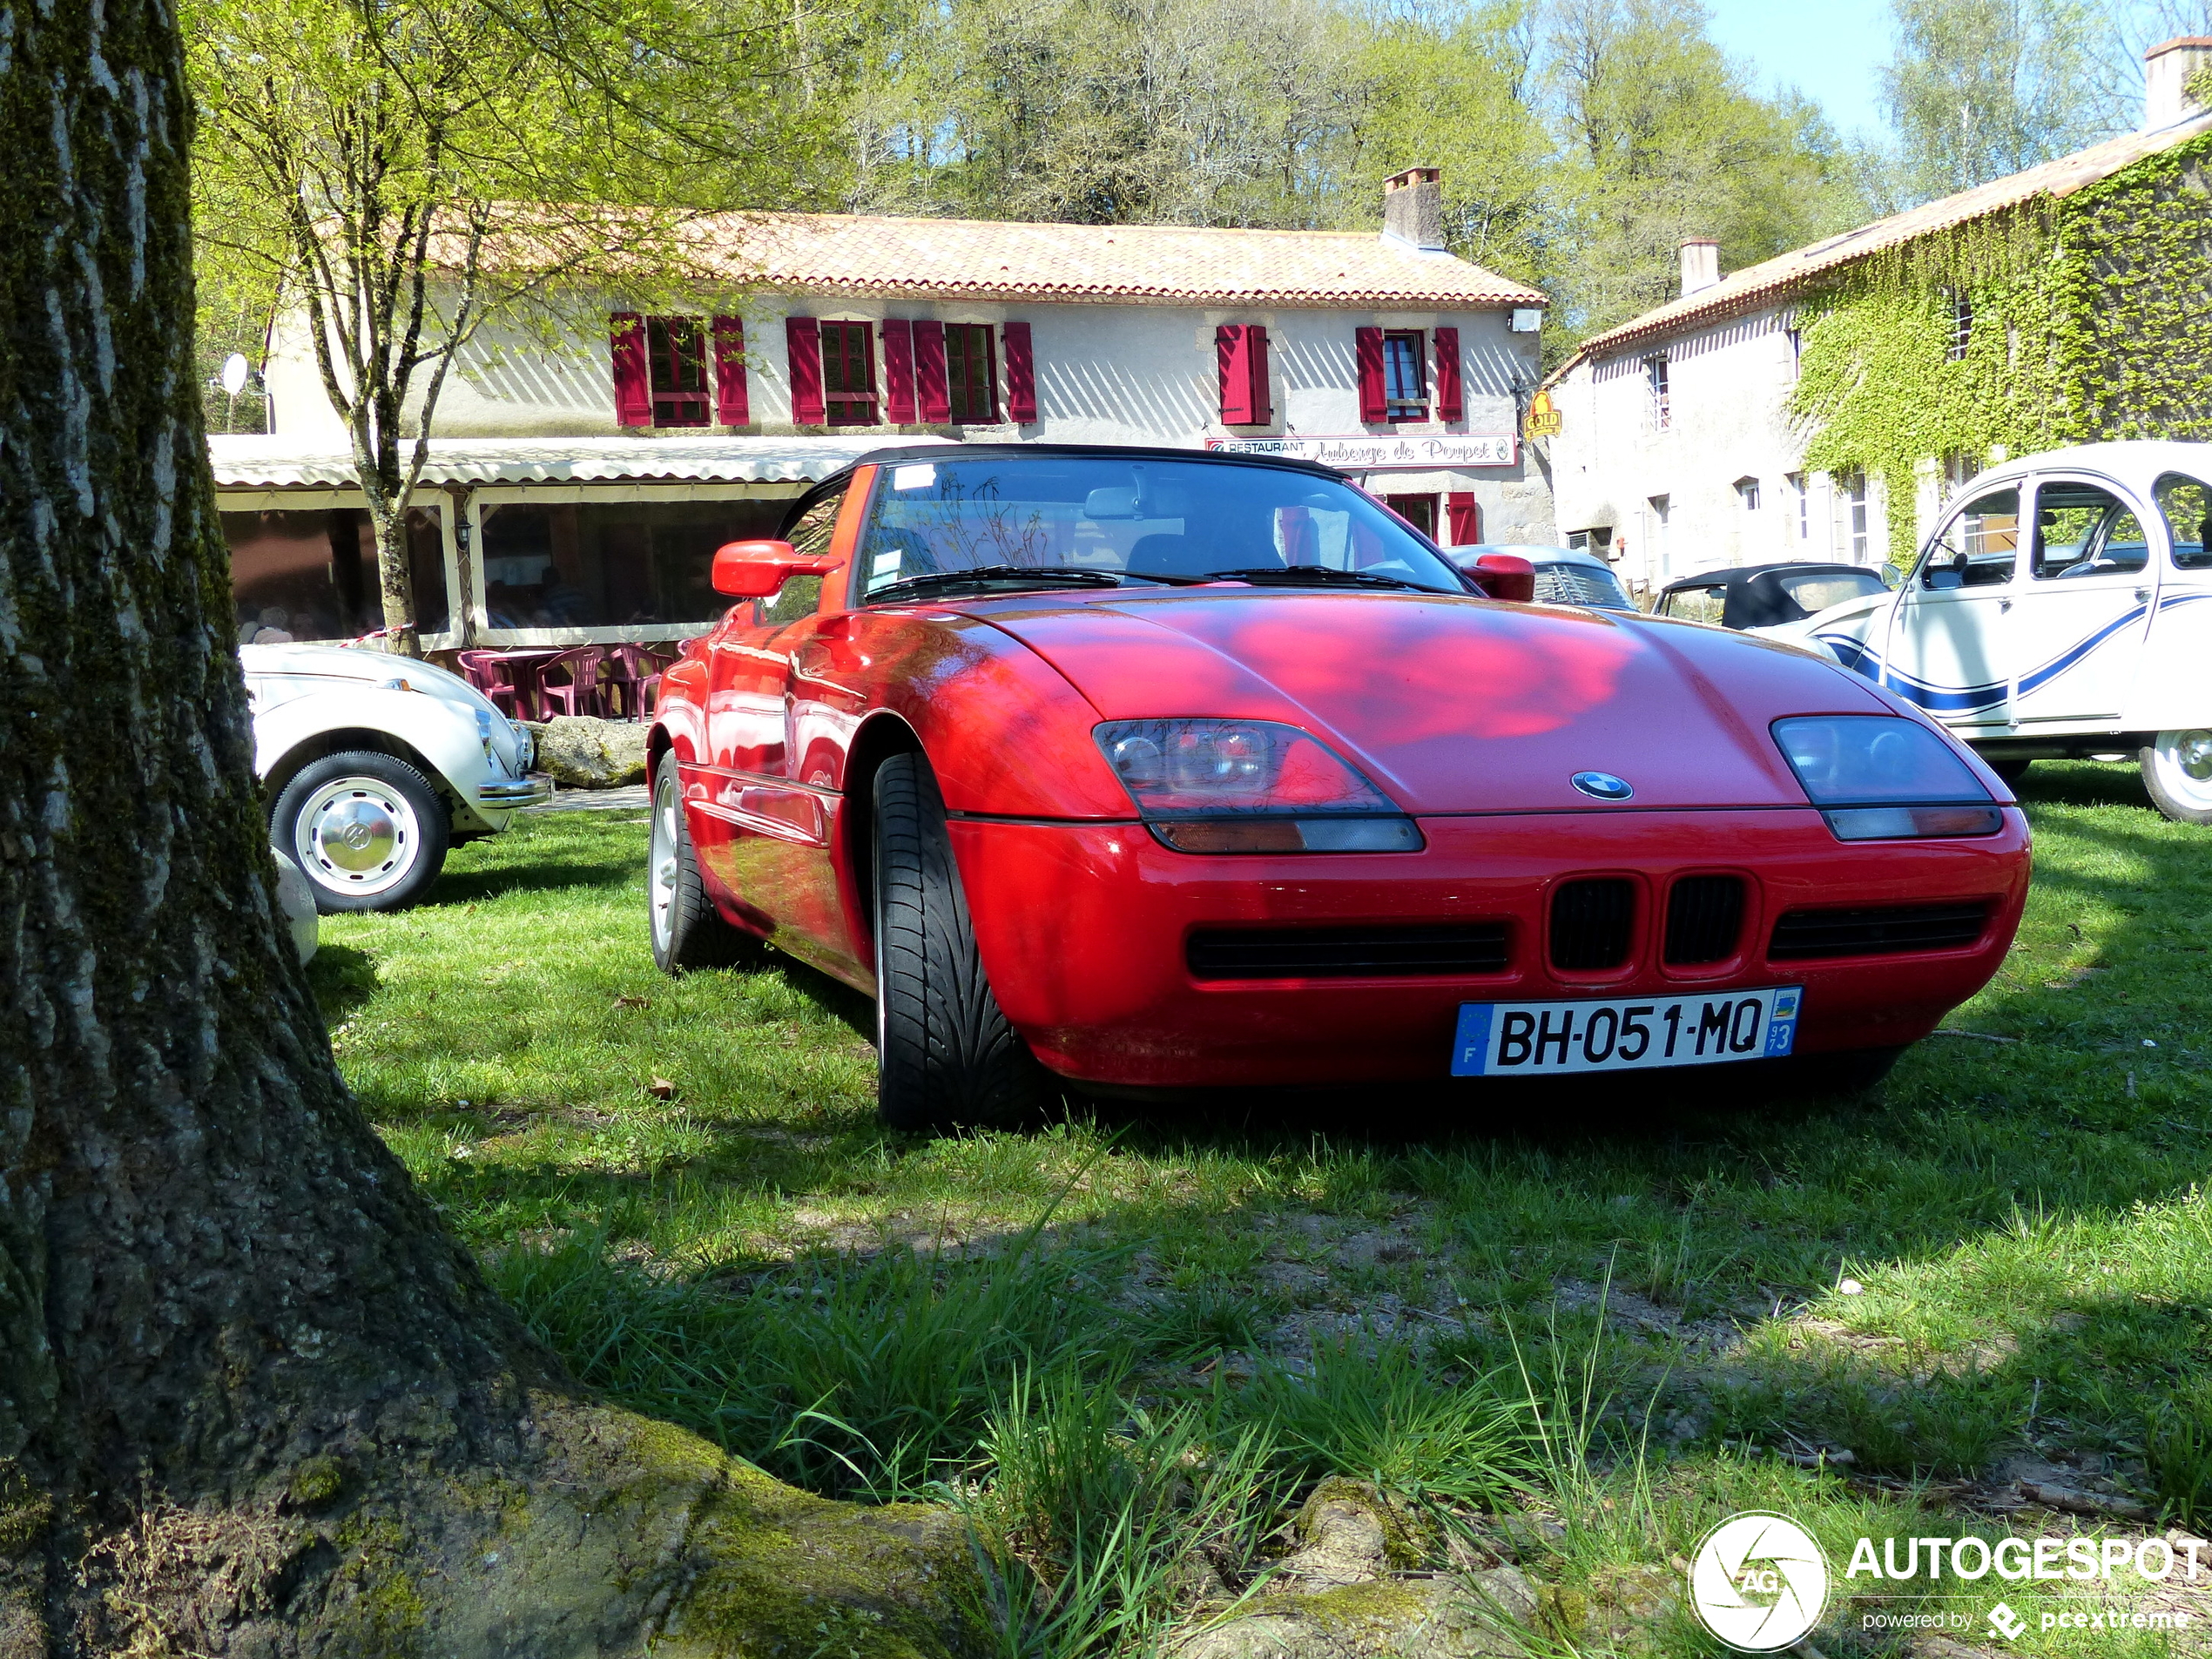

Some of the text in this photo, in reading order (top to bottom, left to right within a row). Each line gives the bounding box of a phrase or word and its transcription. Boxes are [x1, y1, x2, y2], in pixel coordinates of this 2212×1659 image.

[1527, 414, 1558, 429] GOLD
[1229, 442, 1305, 454] RESTAURANT
[1304, 441, 1387, 465] Auberge
[1394, 441, 1415, 460] de
[1421, 439, 1490, 464] Poupet
[1463, 1047, 1476, 1063] F
[1497, 998, 1763, 1065] BH-051-MQ
